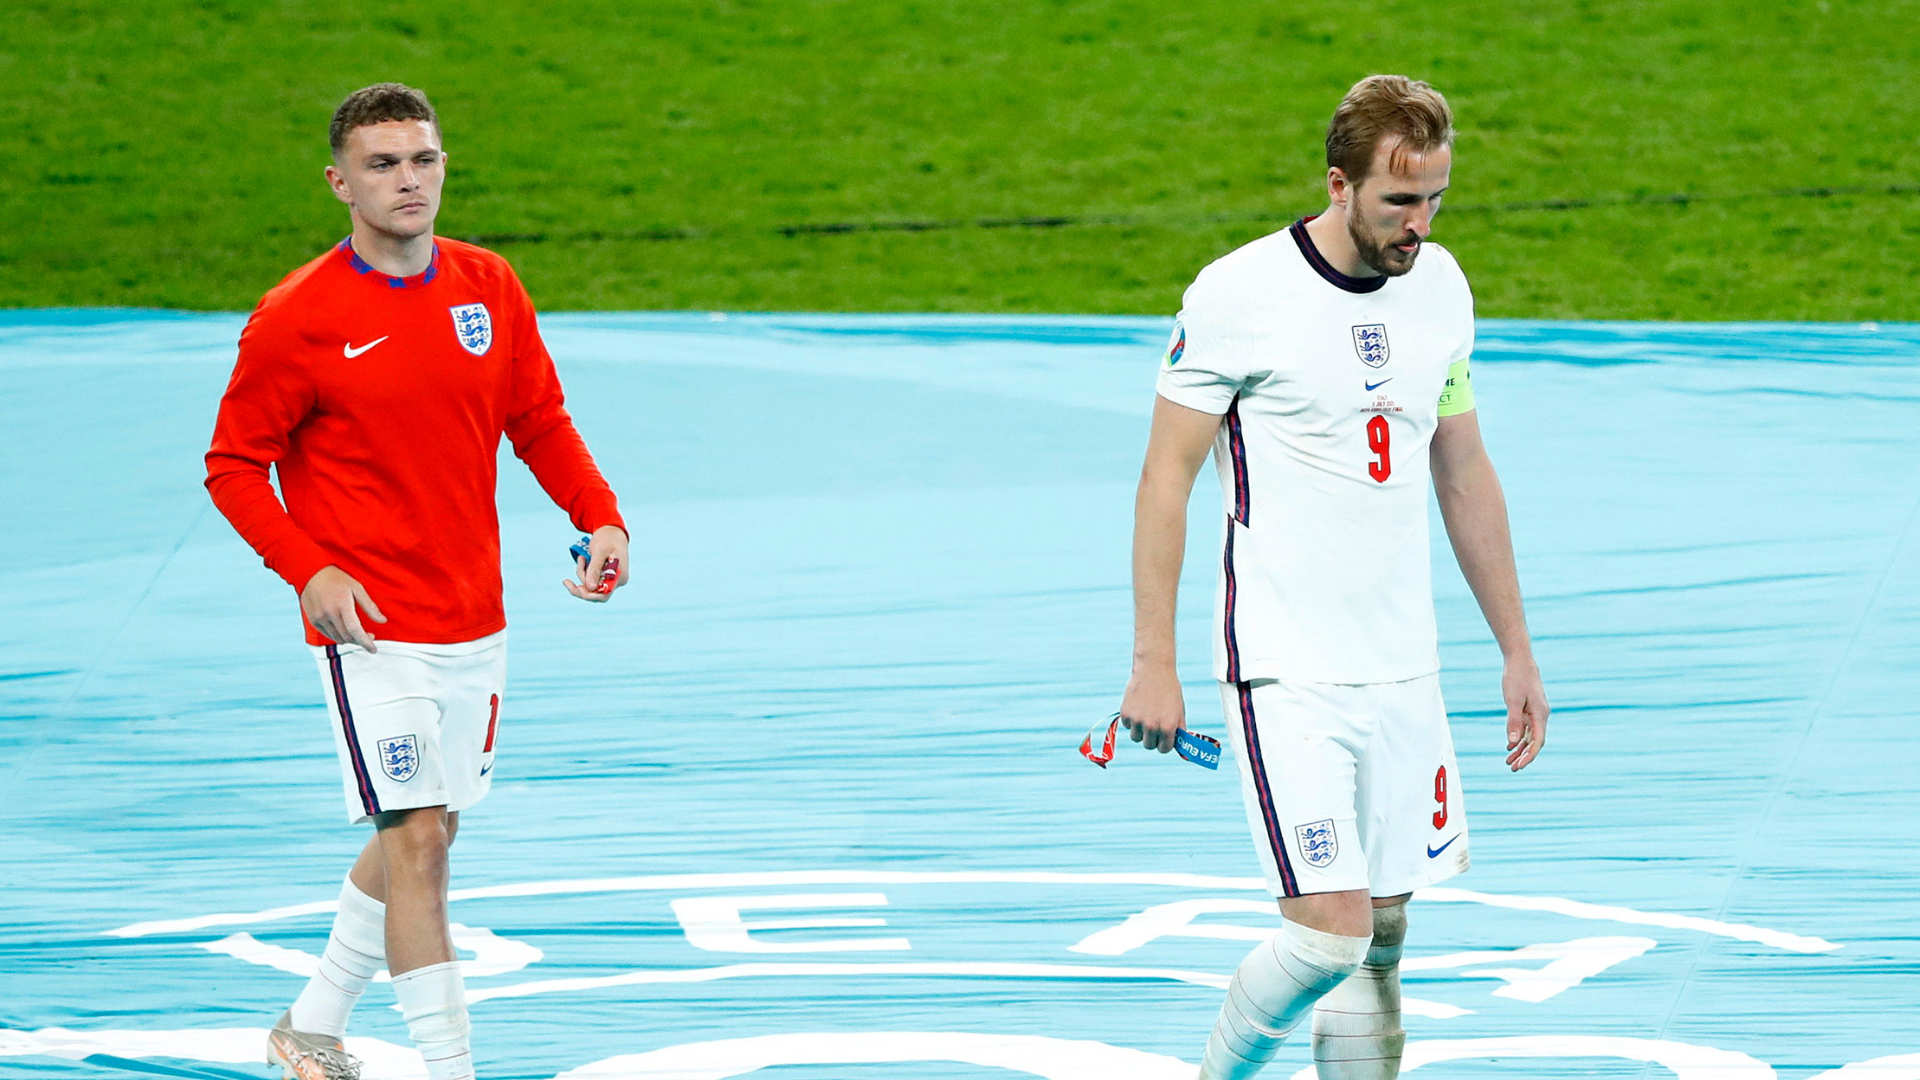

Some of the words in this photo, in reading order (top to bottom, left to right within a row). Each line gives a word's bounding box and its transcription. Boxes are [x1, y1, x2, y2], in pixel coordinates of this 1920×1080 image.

[1438, 394, 1451, 403] CT
[1367, 415, 1391, 483] 9
[1177, 736, 1199, 757] EURO
[1200, 750, 1221, 763] EFA
[1432, 764, 1448, 830] 9
